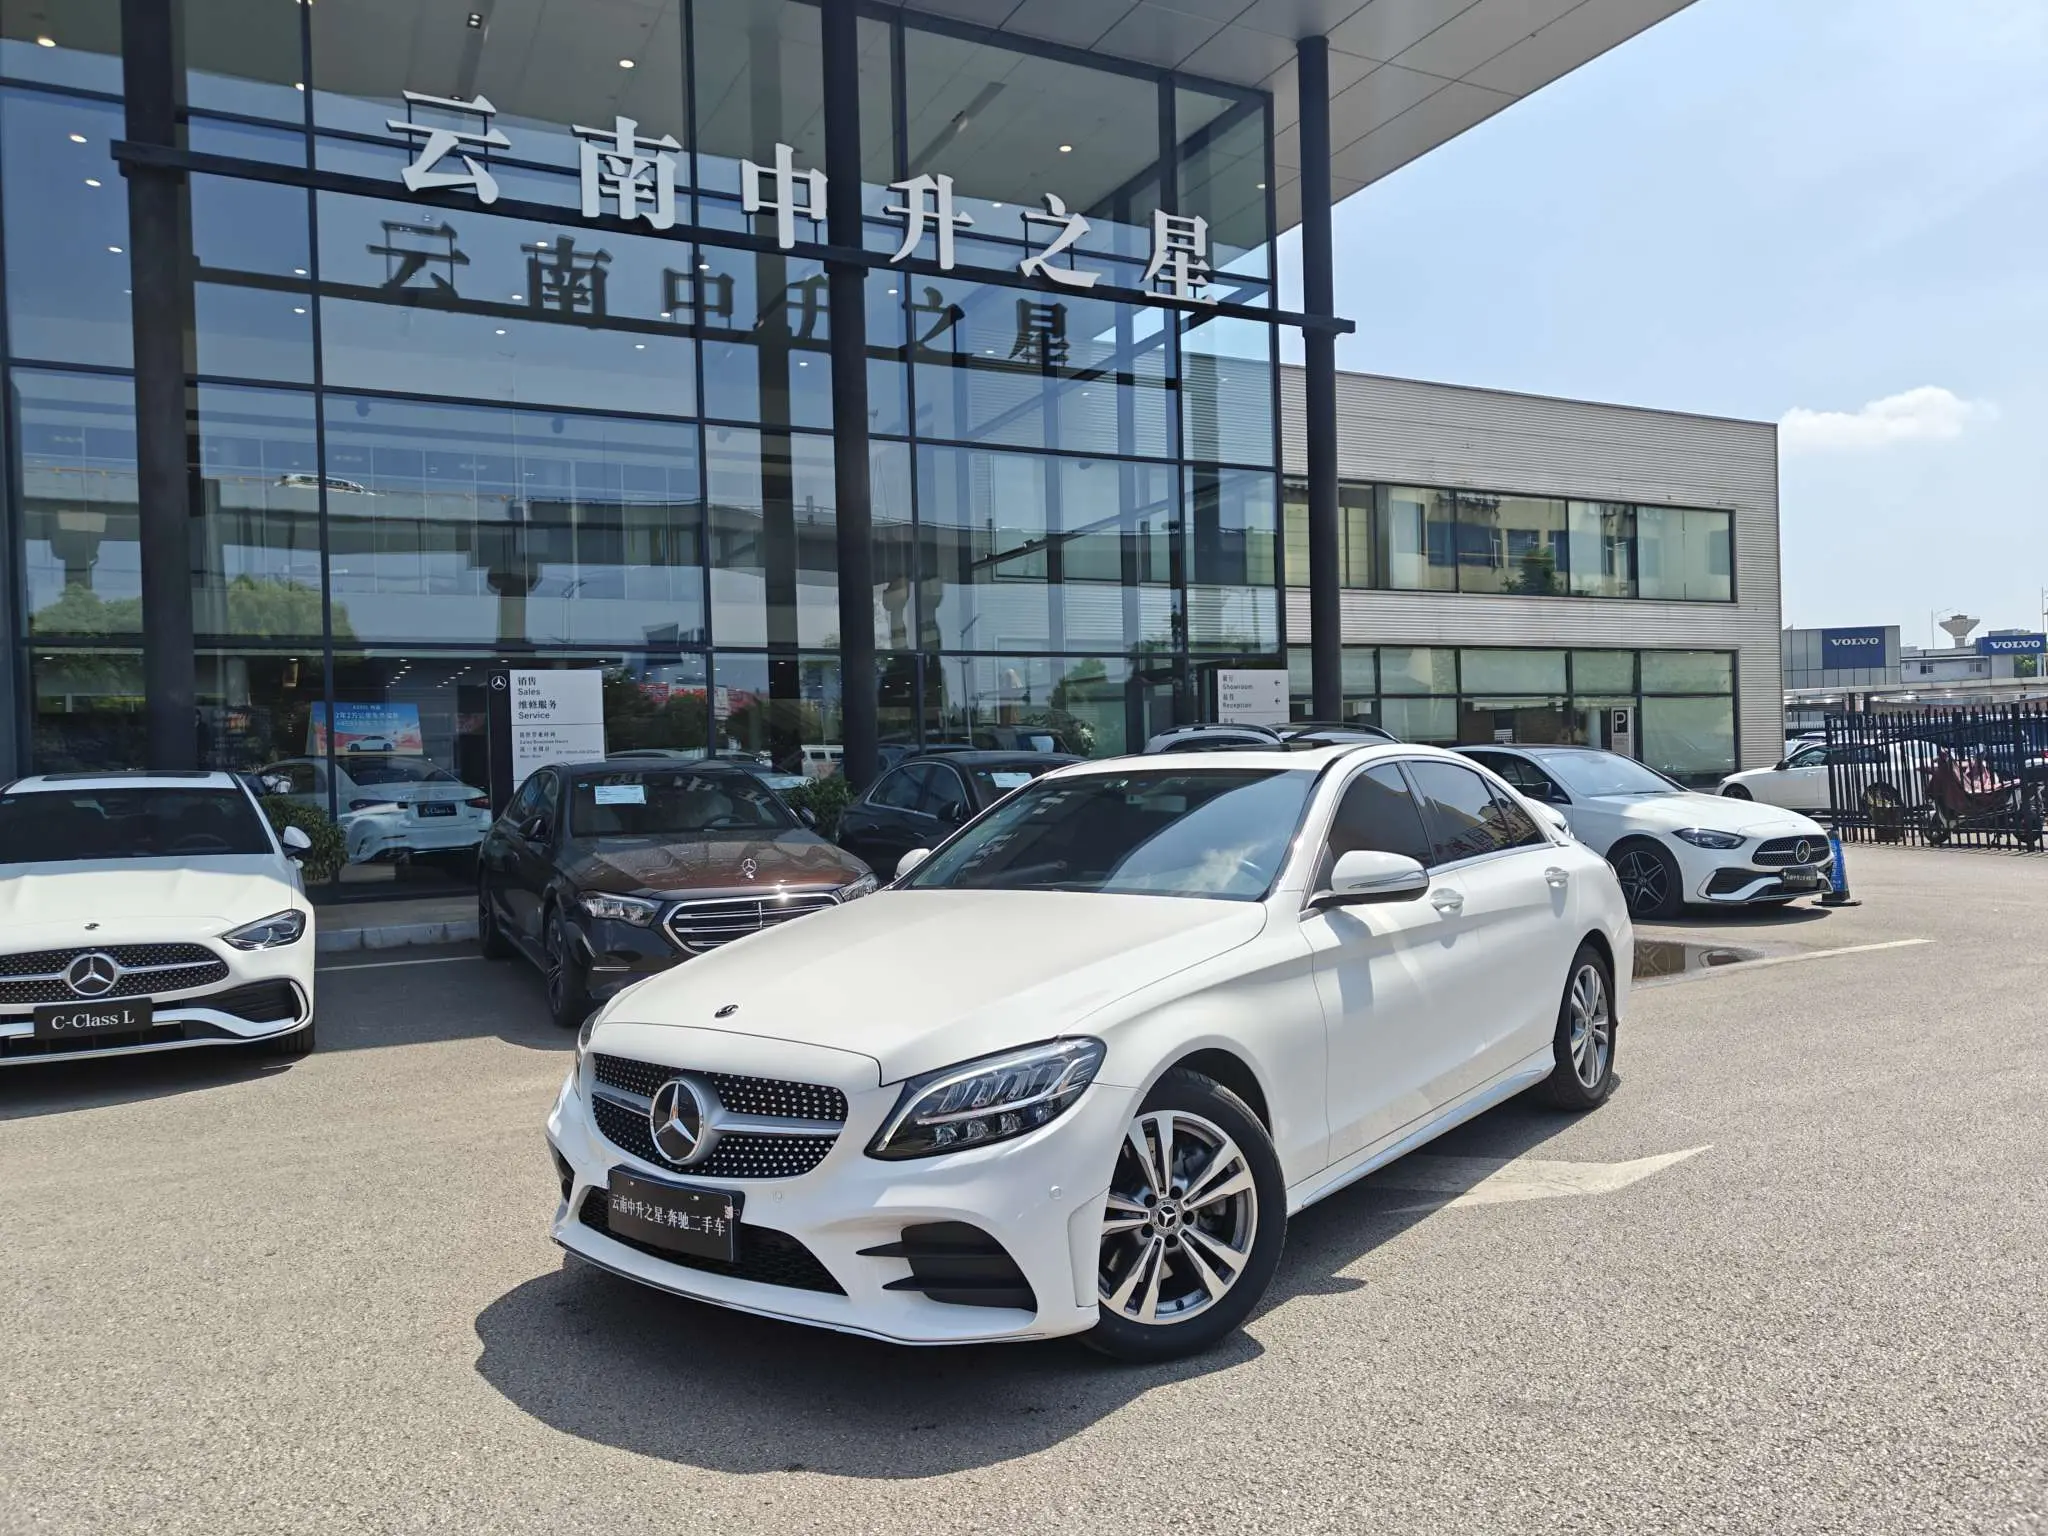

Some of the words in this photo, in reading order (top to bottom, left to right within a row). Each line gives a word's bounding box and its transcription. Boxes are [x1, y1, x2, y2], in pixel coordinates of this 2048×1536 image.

[386, 89, 1218, 306] 云南中升之星
[1831, 637, 1879, 646] VOLVO
[1990, 639, 2041, 649] VOLVO
[518, 688, 541, 696] Sales
[518, 711, 551, 720] Service
[1614, 711, 1626, 731] P
[51, 1012, 119, 1030] C-Class
[123, 1010, 135, 1025] L
